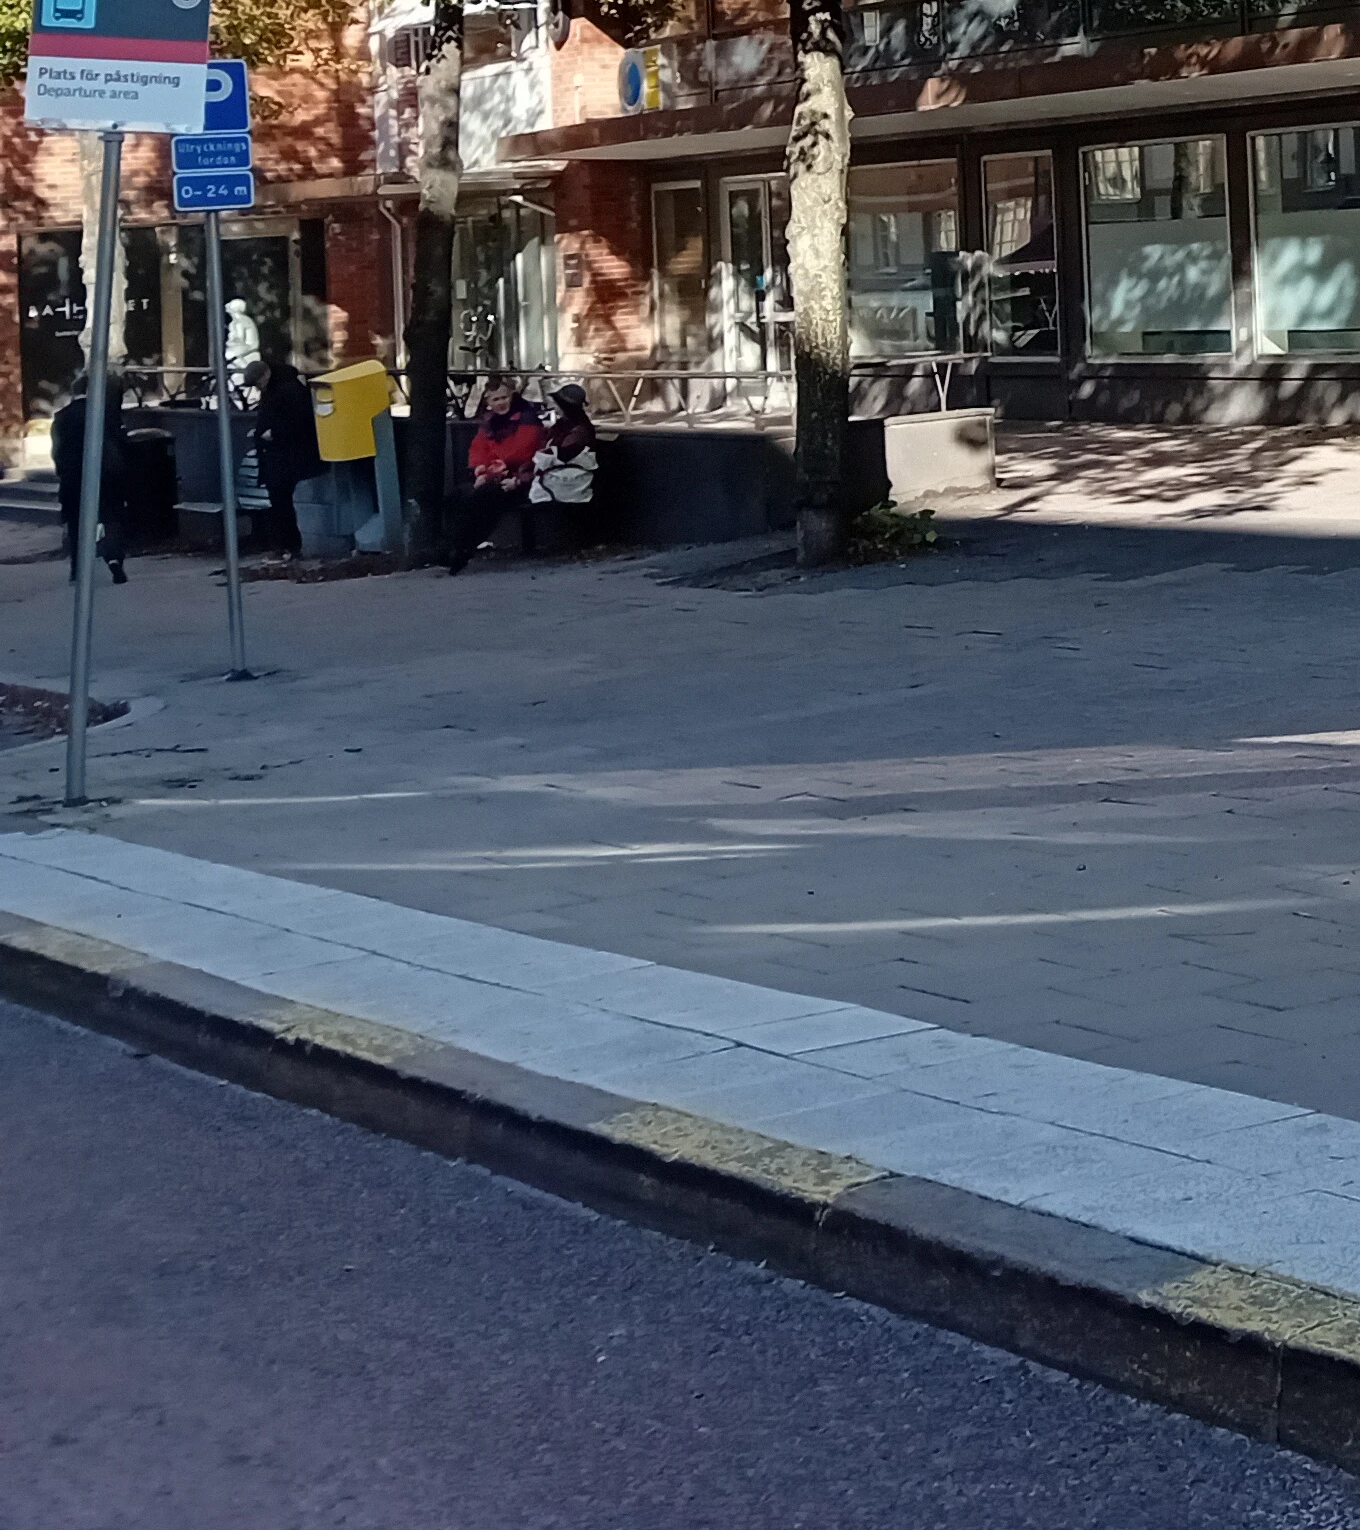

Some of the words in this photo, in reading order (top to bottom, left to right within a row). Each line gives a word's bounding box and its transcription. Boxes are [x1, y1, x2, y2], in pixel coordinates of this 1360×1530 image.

[38, 66, 76, 81] Plats
[80, 69, 101, 82] för
[104, 70, 182, 88] påstigning
[37, 83, 107, 99] Departure
[108, 88, 140, 101] area
